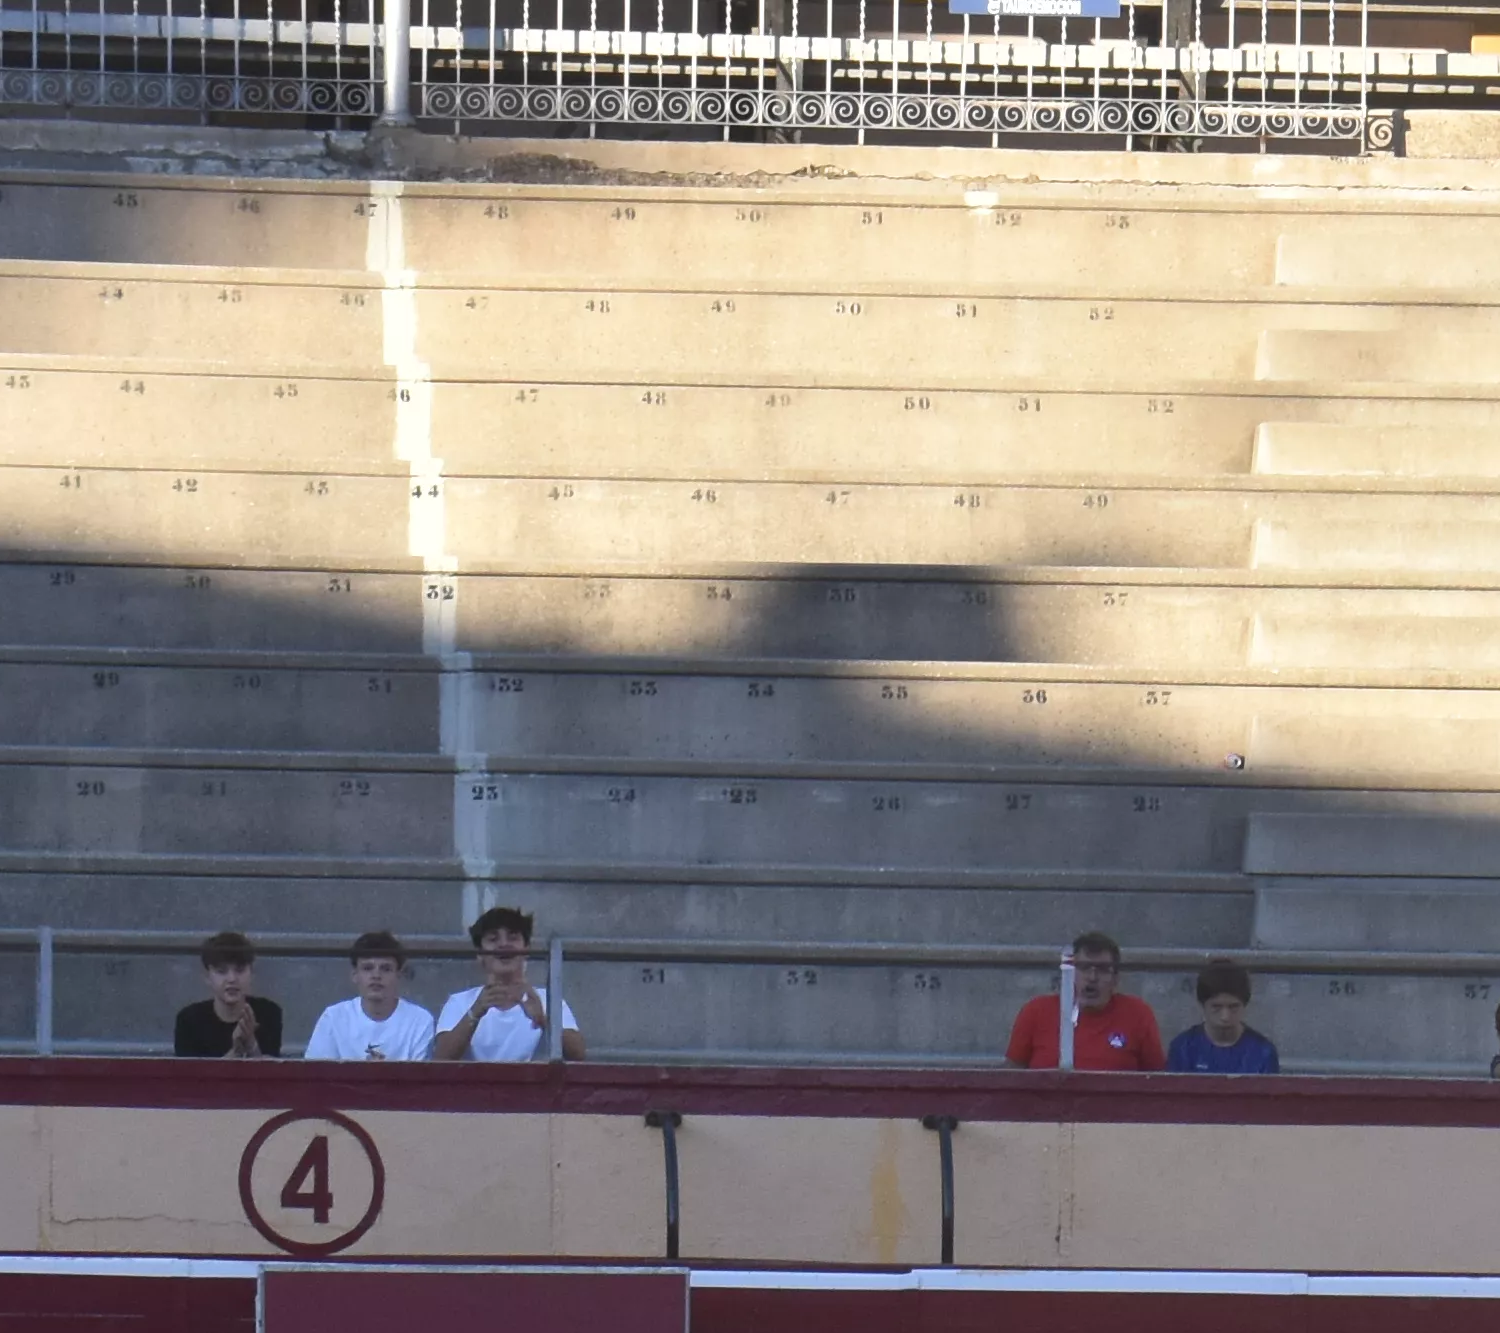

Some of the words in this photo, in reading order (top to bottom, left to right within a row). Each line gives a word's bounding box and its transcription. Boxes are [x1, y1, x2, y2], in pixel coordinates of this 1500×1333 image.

[484, 205, 508, 219] 48
[612, 207, 636, 220] 49
[586, 300, 610, 313] 48
[711, 300, 735, 312] 49
[120, 380, 145, 394] 44
[391, 389, 410, 402] 46
[642, 391, 666, 405] 48
[60, 475, 80, 488] 41
[172, 479, 198, 492] 42
[412, 485, 438, 498] 44
[691, 489, 716, 503] 46
[826, 491, 851, 504] 47
[954, 494, 980, 508] 48
[1083, 495, 1108, 508] 49
[50, 570, 75, 585] 29
[77, 782, 105, 796] 20
[340, 780, 370, 796] 22
[1006, 794, 1031, 810] 27
[280, 1135, 334, 1224] 4
